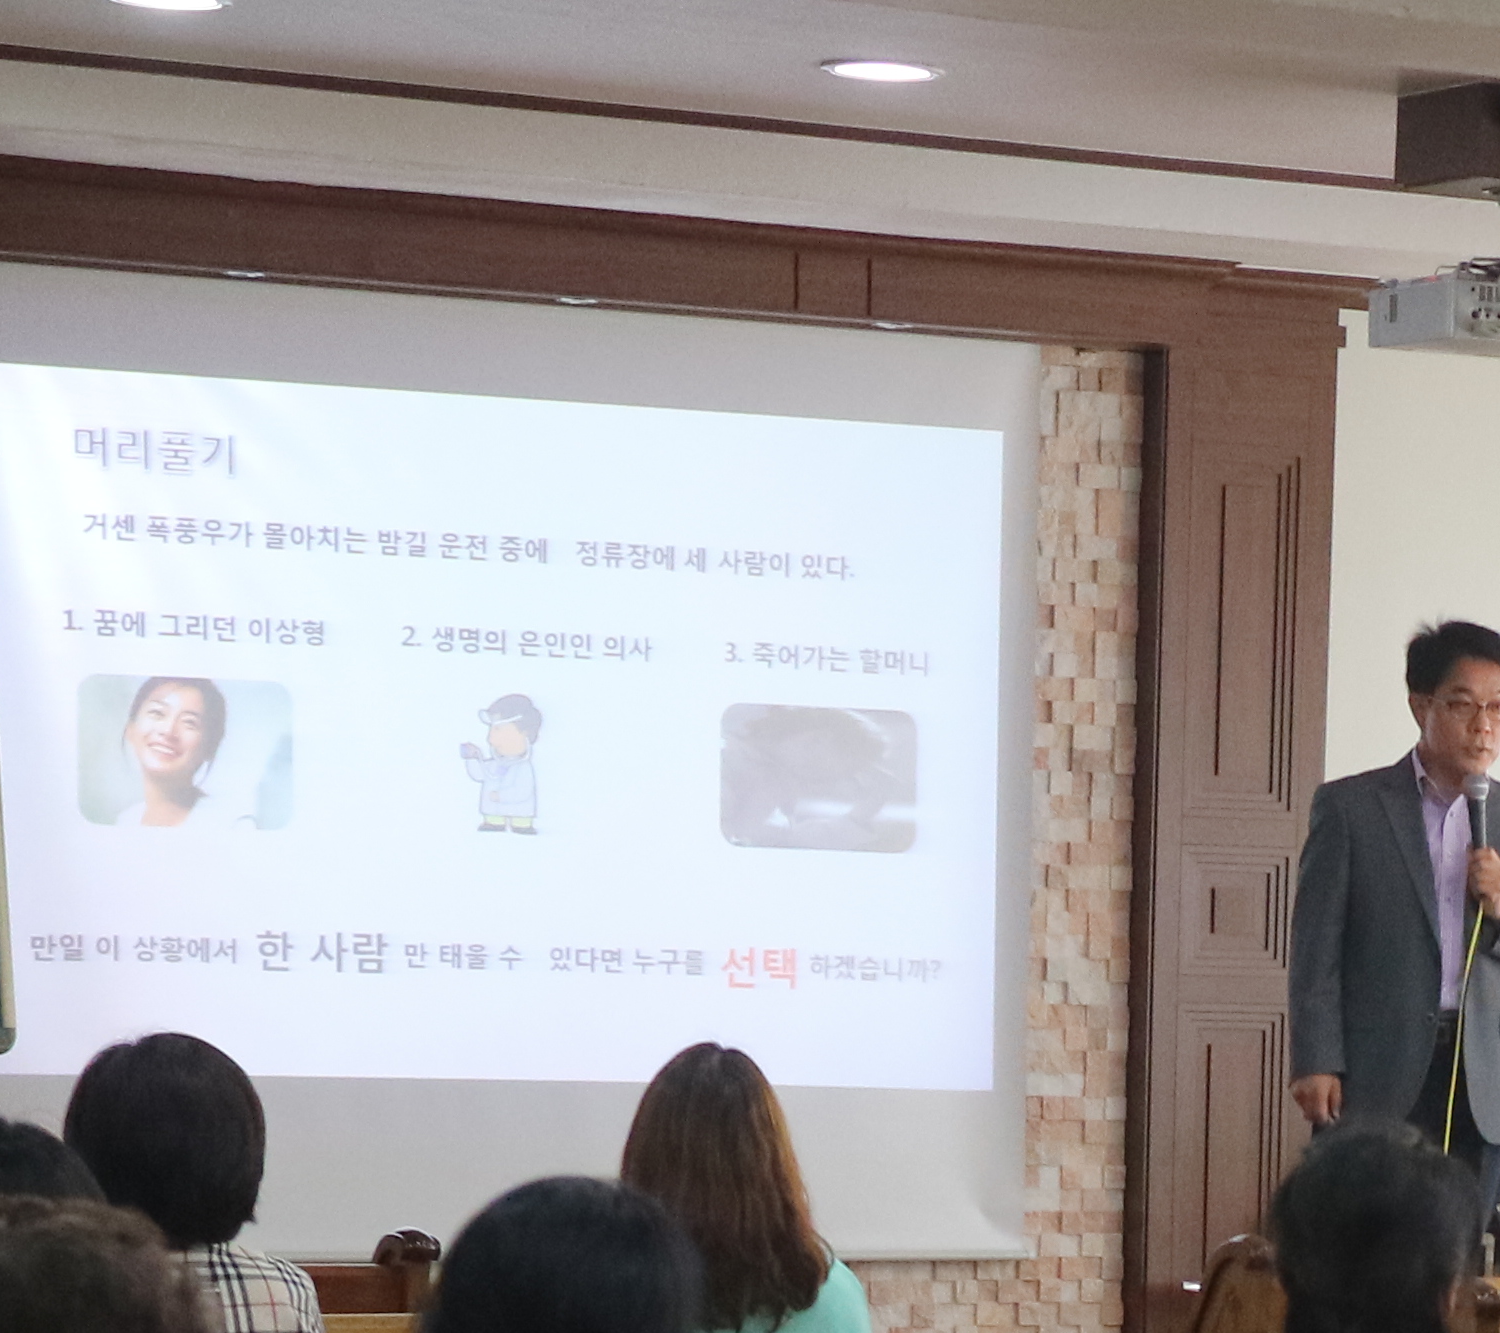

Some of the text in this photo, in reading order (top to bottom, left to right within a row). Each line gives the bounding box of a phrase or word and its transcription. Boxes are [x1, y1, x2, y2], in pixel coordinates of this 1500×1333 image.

[74, 428, 237, 475] 머리풀기
[83, 513, 856, 581] 거센 폭풍우가 몰아치는 밤길 운전 중에 정류장에 세 사람이 있다.
[62, 608, 326, 647] 1. 꿈에 그리던 이상형
[400, 625, 653, 663] 2. 생명의 은인인 의사
[724, 642, 930, 677] 3. 죽어가는 할머니
[29, 934, 85, 962] 만일
[96, 934, 121, 962] 이
[132, 935, 238, 965] 상황에서
[256, 930, 294, 972] 한
[310, 931, 390, 975] 사람
[439, 944, 489, 970] 태울
[498, 945, 523, 970] 수
[549, 947, 623, 974] 있다면
[632, 948, 706, 976] 누구를
[721, 947, 798, 989] 선택
[810, 954, 942, 983] 하겠습니까?
